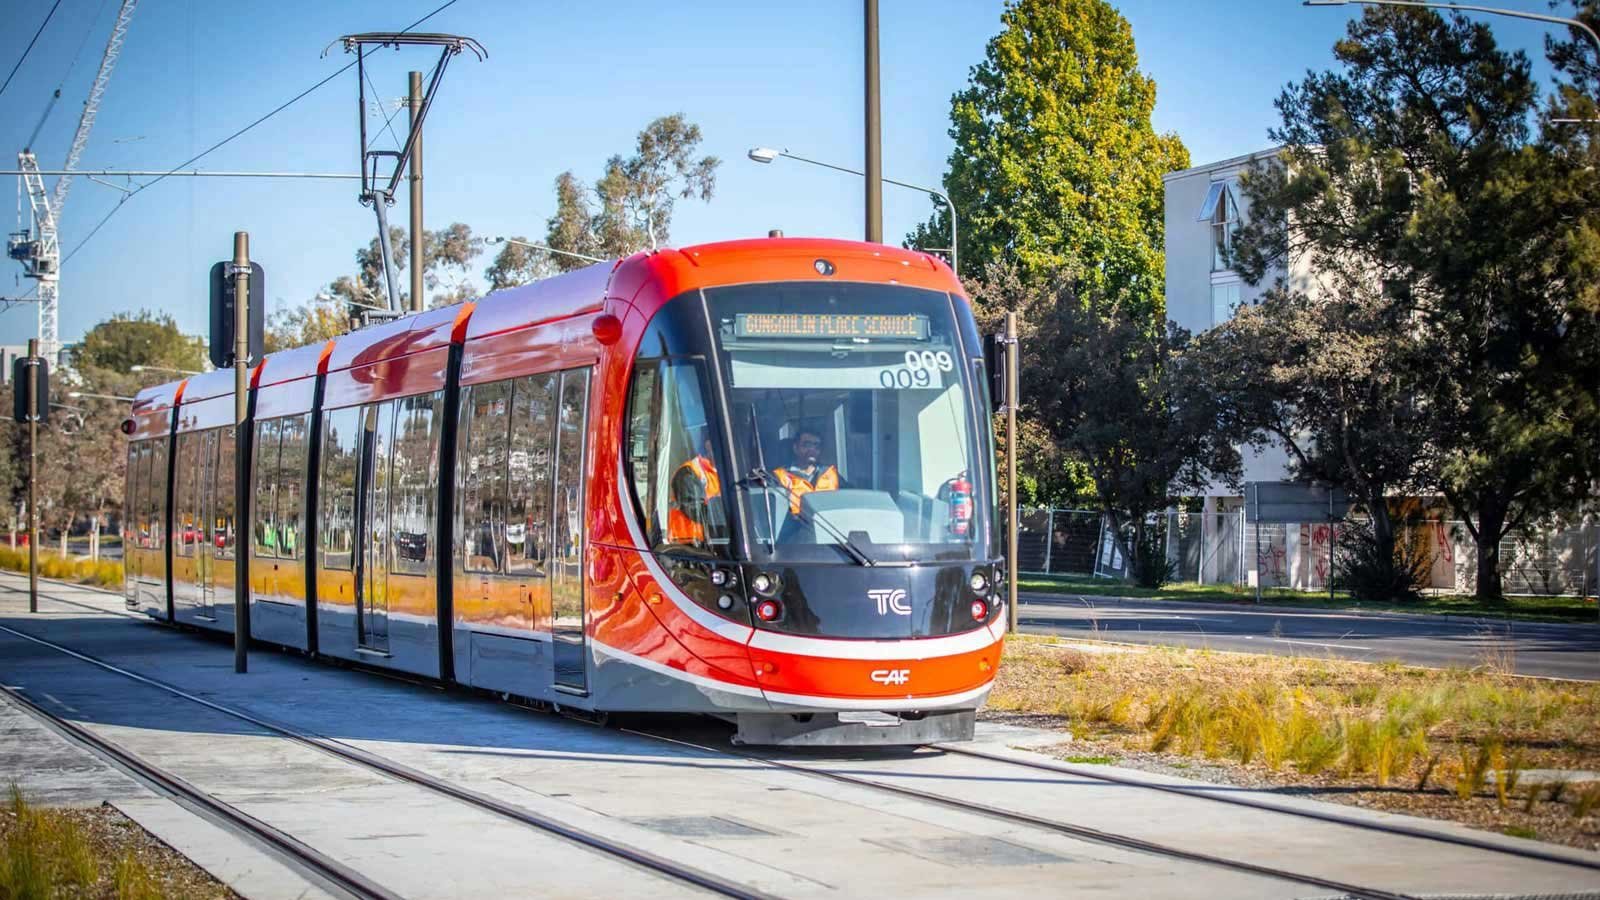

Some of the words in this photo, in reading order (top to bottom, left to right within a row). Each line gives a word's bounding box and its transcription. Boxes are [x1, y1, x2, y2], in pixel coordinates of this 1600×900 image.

[864, 316, 918, 336] SERVICE
[904, 350, 953, 372] 009
[880, 368, 930, 389] 009
[867, 589, 912, 615] TC
[870, 669, 911, 686] CAF
